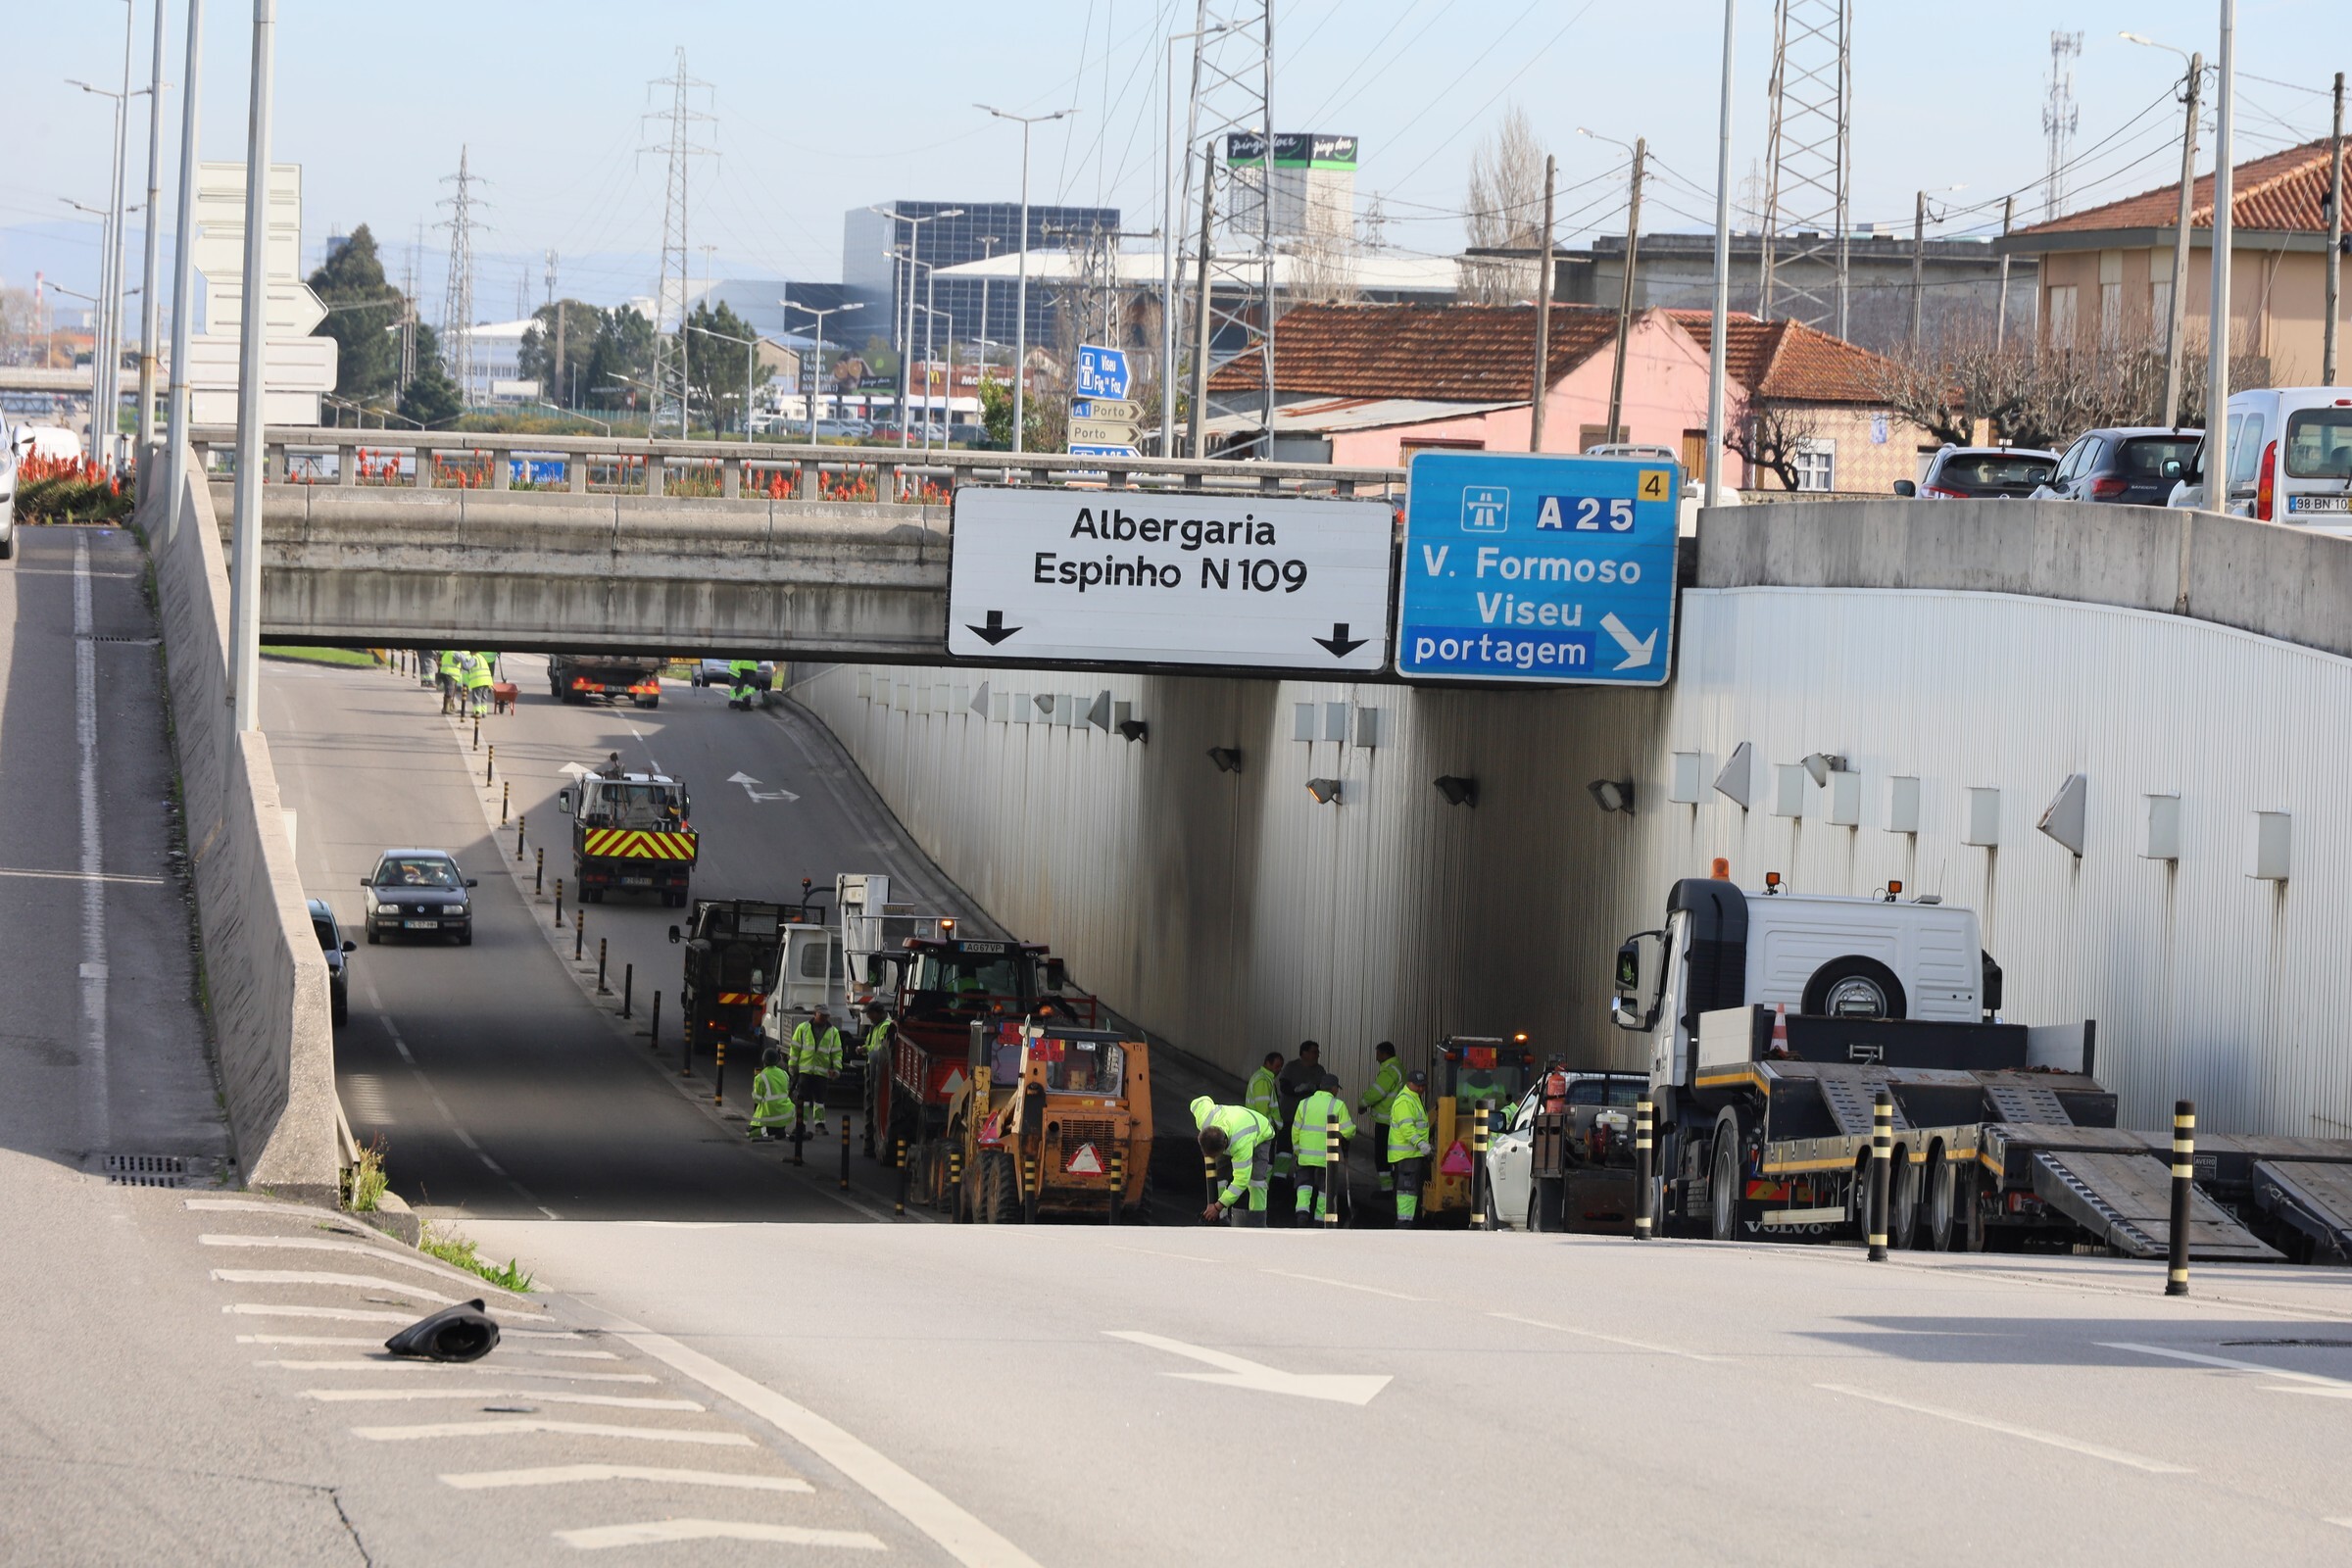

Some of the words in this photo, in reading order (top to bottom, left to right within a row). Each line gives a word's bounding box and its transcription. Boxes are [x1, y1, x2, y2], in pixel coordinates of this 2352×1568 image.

[1313, 139, 1334, 159] pingo
[1335, 136, 1352, 151] doce
[1101, 354, 1116, 372] Viseu
[1110, 376, 1122, 394] Foz
[1093, 405, 1125, 416] Porto
[1074, 426, 1106, 439] Porto
[1644, 474, 1661, 497] 4
[1070, 507, 1276, 551] Albergaria
[1034, 552, 1182, 593] Espinho
[1422, 544, 1455, 577] V.
[1476, 546, 1642, 585] Formoso
[1476, 591, 1583, 627] Viseu
[1414, 633, 1587, 669] portagem
